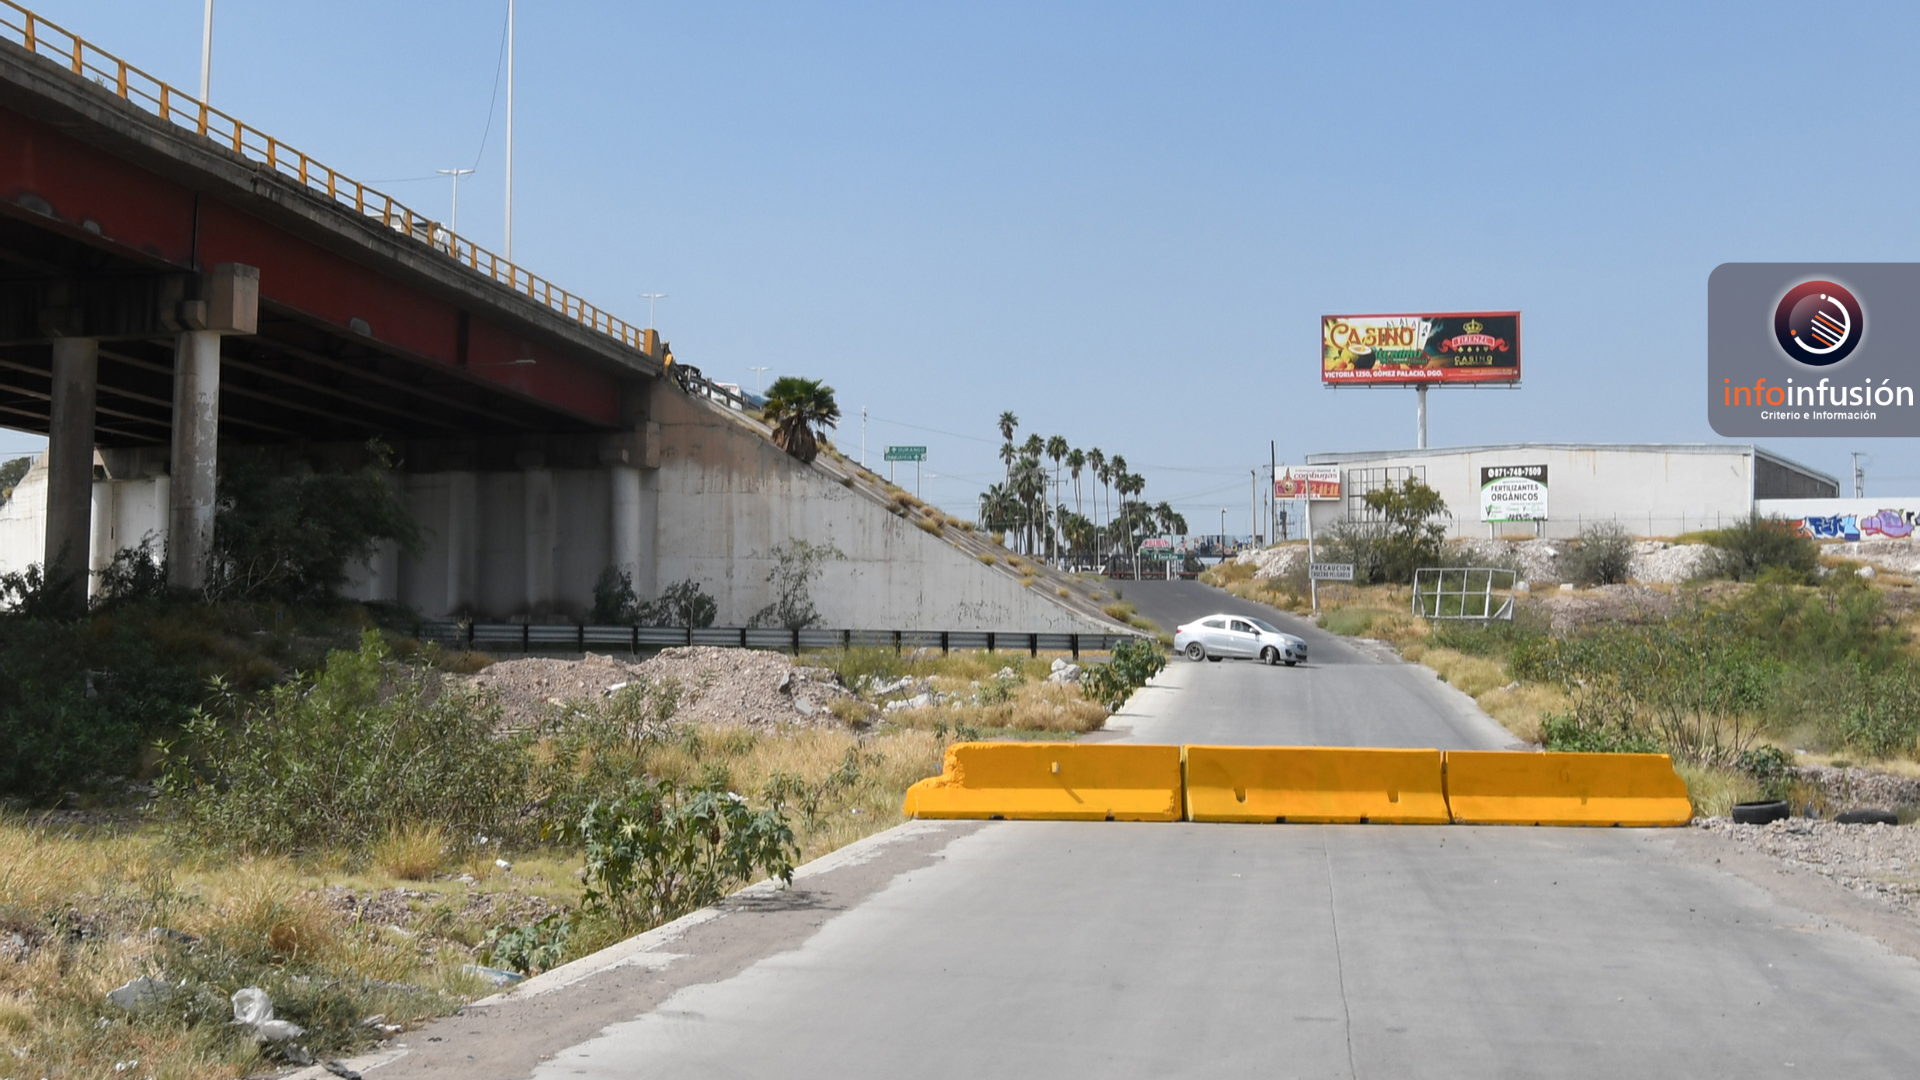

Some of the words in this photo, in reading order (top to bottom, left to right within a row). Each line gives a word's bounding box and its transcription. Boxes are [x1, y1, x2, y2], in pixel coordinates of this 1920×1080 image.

[1330, 323, 1415, 350] CASINO
[1454, 355, 1493, 363] CASINO
[1324, 371, 1355, 379] VICTORIA
[1397, 370, 1426, 378] PALACIO,
[1491, 484, 1539, 492] FERTILIZANTES
